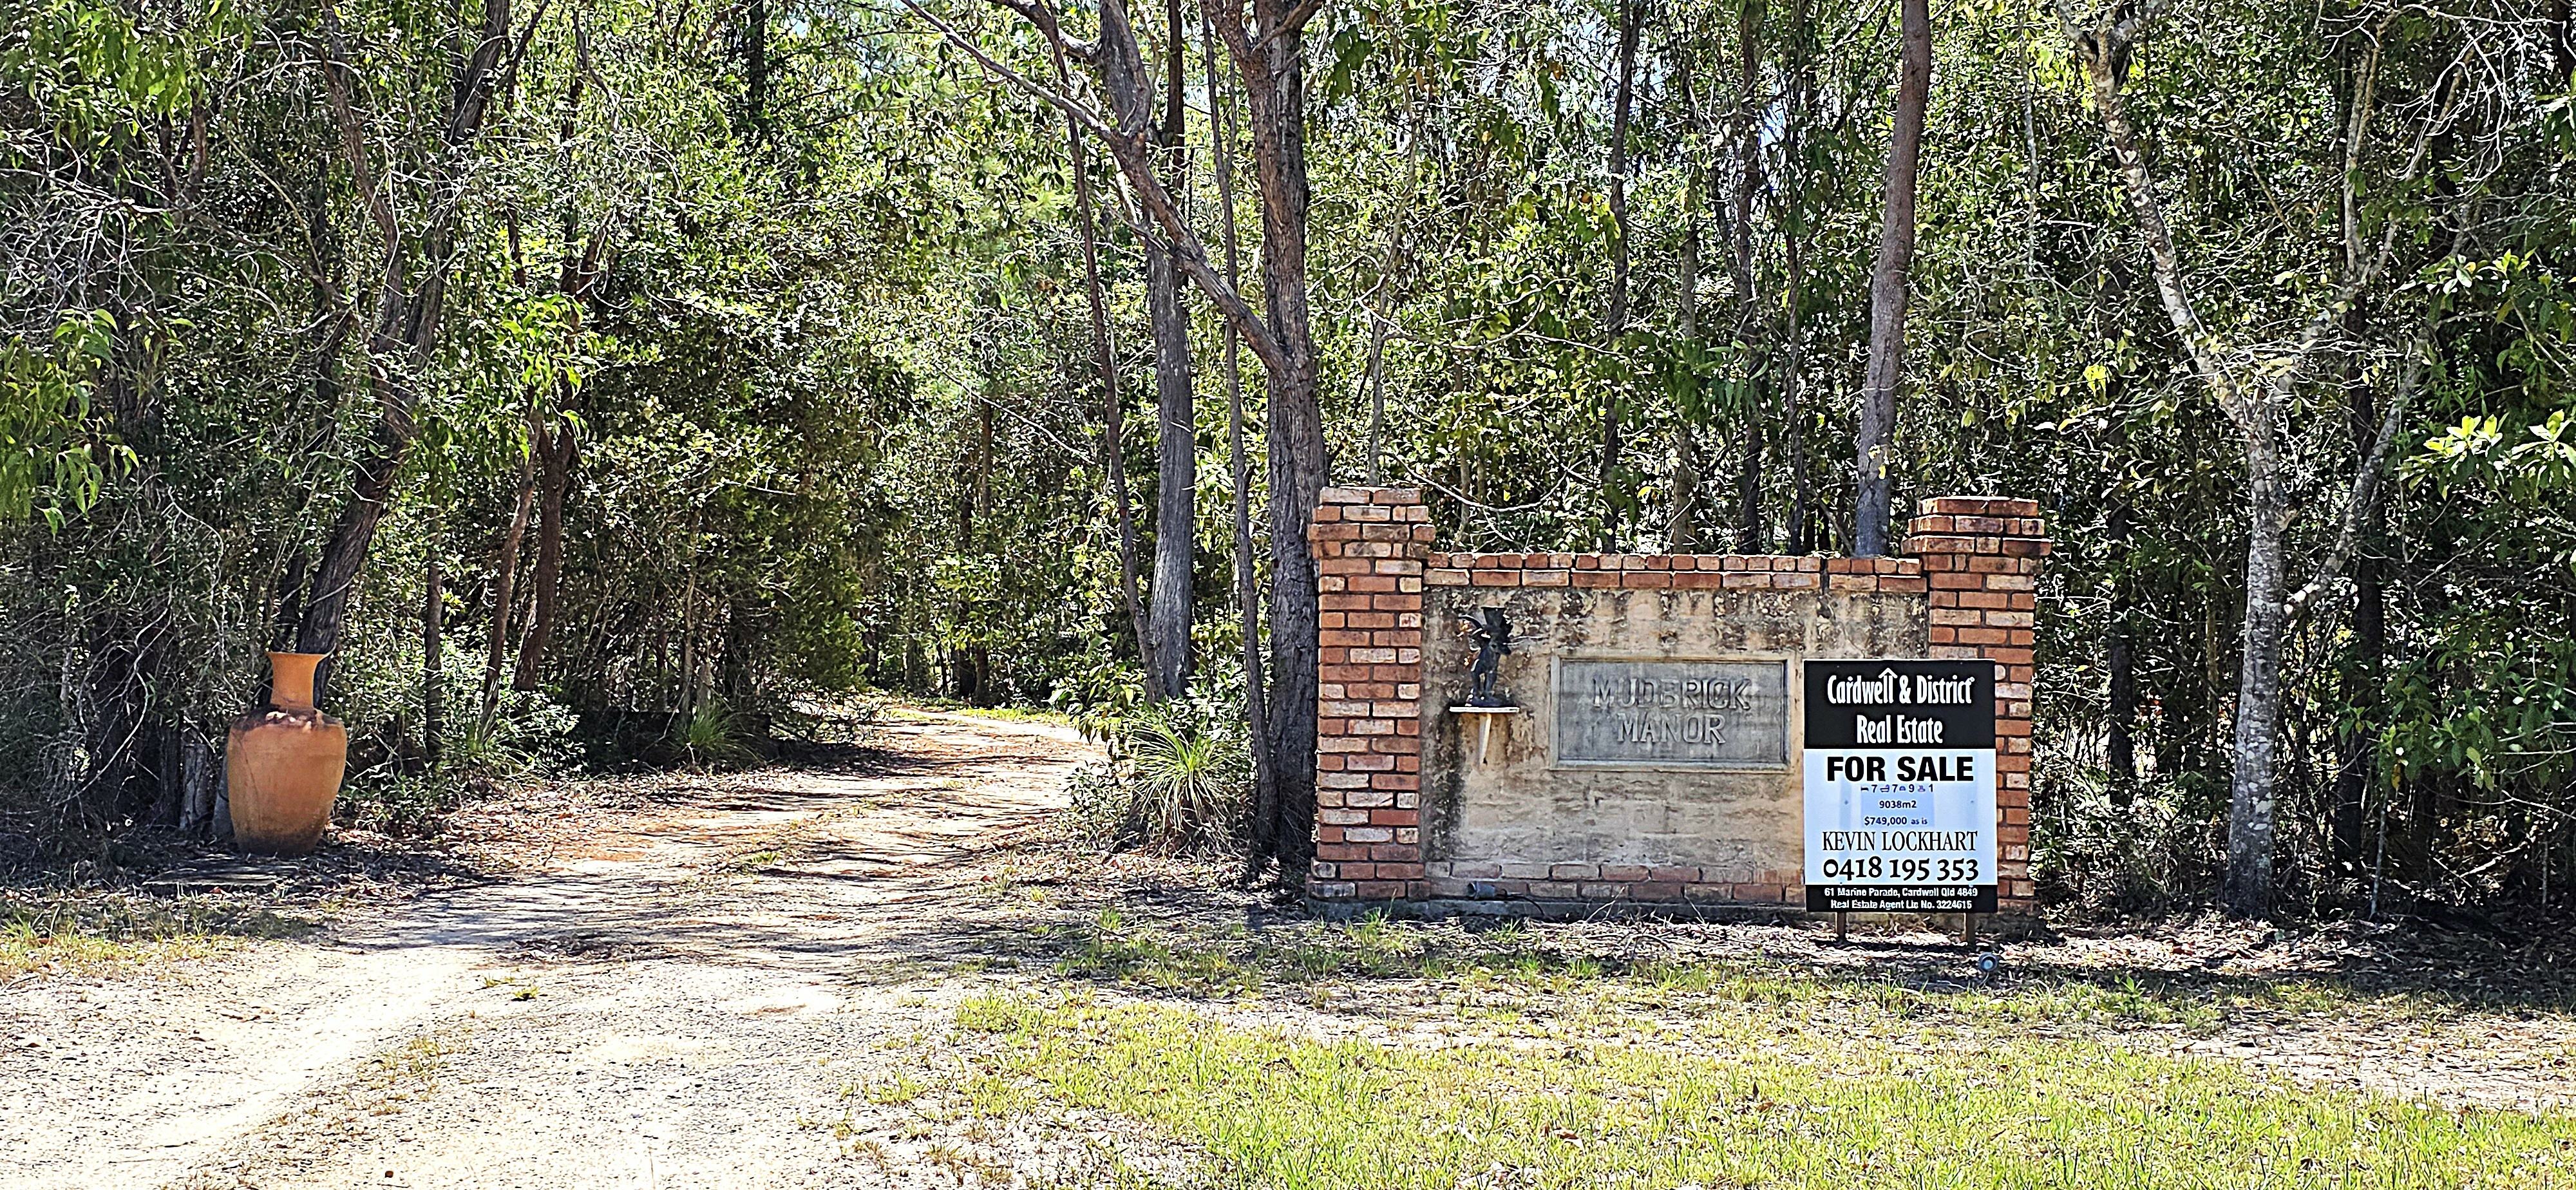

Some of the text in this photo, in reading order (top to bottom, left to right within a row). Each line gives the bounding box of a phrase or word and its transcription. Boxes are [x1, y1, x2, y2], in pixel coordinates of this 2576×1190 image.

[1592, 678, 1752, 710] MUDBRICK
[1827, 674, 1973, 704] Cardwell & District
[1617, 713, 1726, 744] MANOR
[1857, 715, 1943, 743] Real Estate
[1827, 756, 1974, 781] FOR SALE
[1871, 783, 1933, 793] 7 7 9 1
[1879, 800, 1917, 809] 9038m2
[1864, 815, 1908, 826] $749,000
[1822, 831, 1978, 851] KEVIN LOCKHART
[1823, 856, 1979, 882] 0418 195 353
[1824, 887, 1835, 896] 61
[1837, 887, 1867, 896] Marine
[1902, 887, 1939, 896] Cardwell
[1941, 887, 1955, 896] Qld
[1956, 887, 1978, 896] 4849
[1830, 899, 1973, 910] Real Estate Agent Lic No. 3224615
